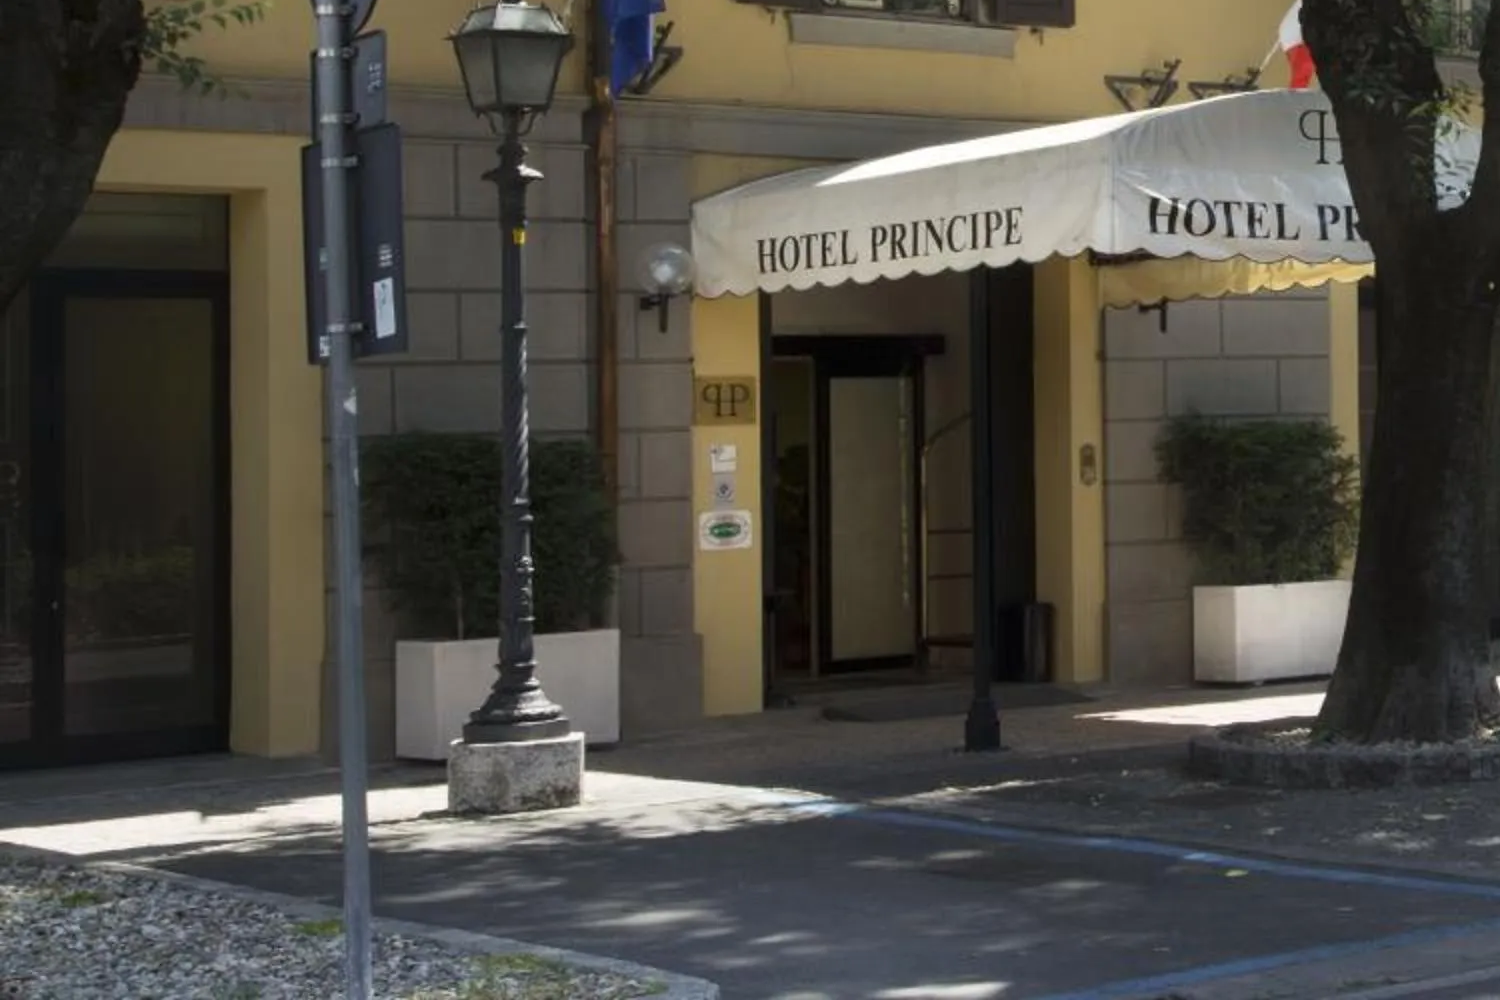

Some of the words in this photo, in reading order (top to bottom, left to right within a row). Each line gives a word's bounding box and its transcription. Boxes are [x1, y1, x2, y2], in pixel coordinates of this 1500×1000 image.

[757, 230, 858, 274] HOTEL
[870, 206, 1023, 263] PRINCIPE
[1149, 197, 1300, 241] HOTEL
